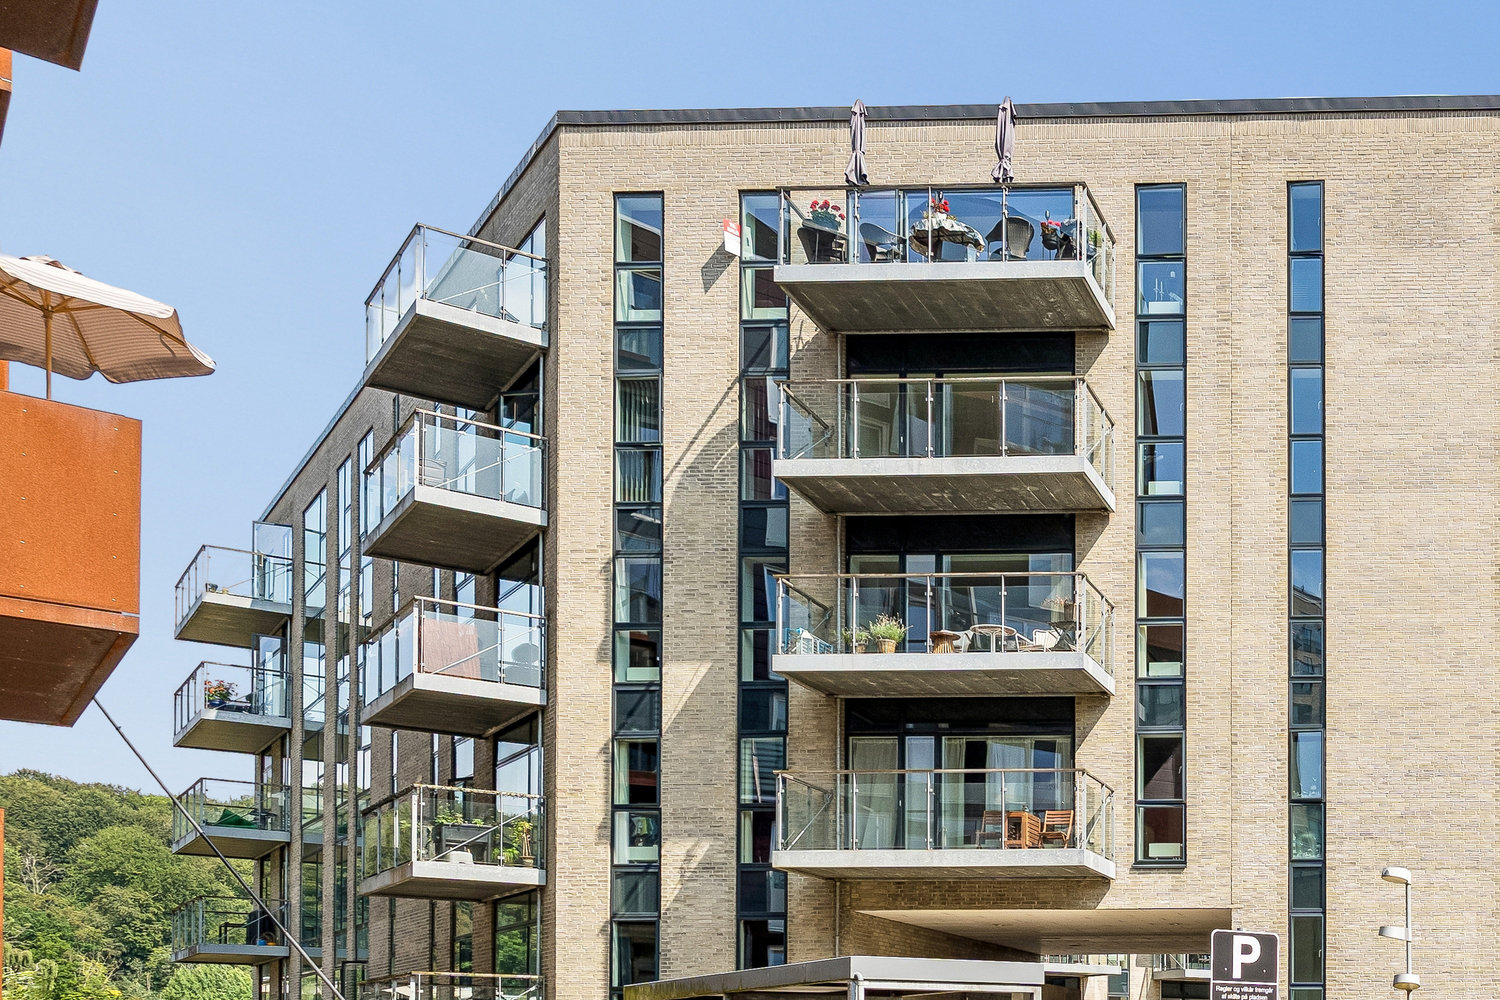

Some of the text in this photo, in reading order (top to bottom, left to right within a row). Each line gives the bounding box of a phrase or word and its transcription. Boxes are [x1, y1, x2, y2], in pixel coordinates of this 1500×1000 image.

[1232, 934, 1262, 979] P
[1215, 985, 1233, 993] Regler
[1240, 993, 1248, 1000] på
